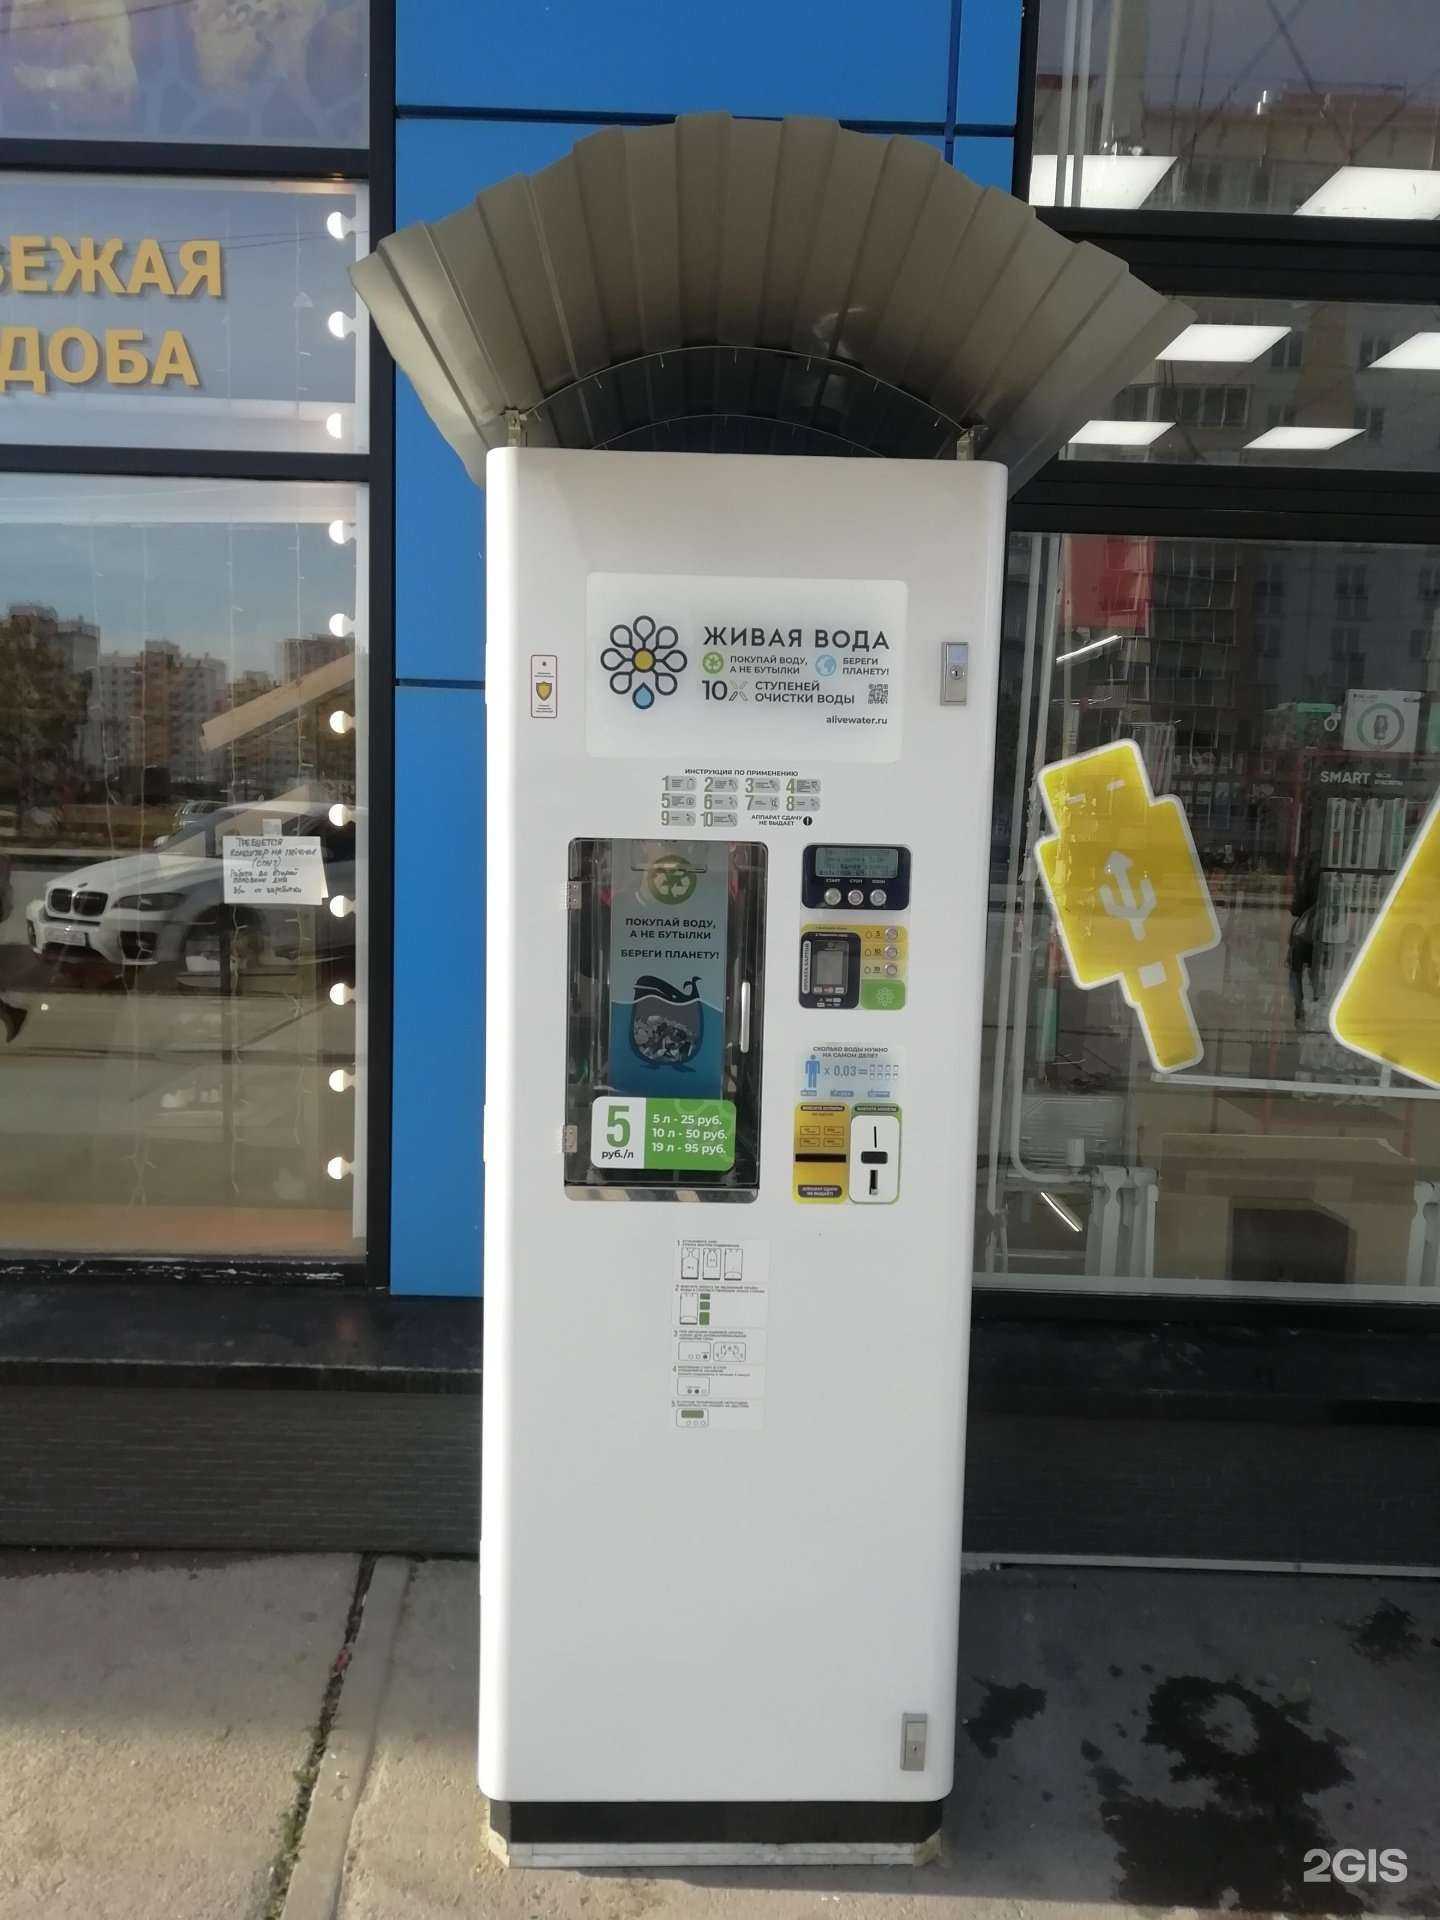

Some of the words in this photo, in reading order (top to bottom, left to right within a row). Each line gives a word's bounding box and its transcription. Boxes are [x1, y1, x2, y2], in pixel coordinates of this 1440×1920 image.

[0, 234, 222, 296] ЕЖАЯ
[703, 626, 803, 648] ЖИВАЯ
[814, 629, 890, 652] ВОДА
[729, 654, 778, 664] ПОКУПАЙ
[779, 656, 808, 667] ВОДУ,
[842, 657, 878, 666] БЕРЕГИ
[729, 665, 737, 674] А
[739, 666, 752, 674] НЕ
[754, 666, 800, 675] БУТЫЛКИ
[842, 667, 889, 677] ПЛАНЕТУ!
[755, 678, 820, 692] СТУПЕНЕЙ
[754, 692, 815, 704] ОЧИСТКИ
[817, 694, 855, 706] ВОДЫ
[826, 716, 888, 726] alivewater.ru
[684, 768, 733, 776] ИНСТРУКЦИЯ
[734, 769, 745, 777] ПО
[746, 769, 799, 778] ПРИМЕНЕНИЮ
[1320, 771, 1371, 785] SMART
[662, 776, 669, 791] 1
[704, 777, 714, 793] 2
[745, 778, 754, 794] 3
[786, 779, 795, 794] 4
[661, 793, 671, 809] 5
[704, 794, 713, 810] 6
[745, 795, 755, 811] 7
[786, 795, 795, 812] 8
[661, 811, 670, 826] 9
[701, 811, 714, 828] 10
[625, 917, 680, 927] ПОКУПАЙ
[683, 919, 717, 929] ВОДУ,
[630, 930, 637, 938] А
[640, 930, 655, 938] НЕ
[658, 930, 711, 940] БУТЫЛКИ
[621, 949, 662, 958] БЕРЕГИ
[665, 950, 720, 960] ПЛАНЕТУ!
[606, 1105, 631, 1148] 5
[653, 1114, 660, 1123] 5
[662, 1115, 670, 1123] л
[681, 1115, 694, 1124] 25
[698, 1115, 722, 1127] руб.
[653, 1128, 665, 1138] 10
[667, 1130, 675, 1138] л
[686, 1129, 700, 1138] 50
[703, 1130, 728, 1141] руб.
[601, 1150, 634, 1160] руб./л
[652, 1142, 664, 1152] 19
[666, 1144, 674, 1152] л
[685, 1143, 699, 1153] 95
[702, 1144, 726, 1156] руб.
